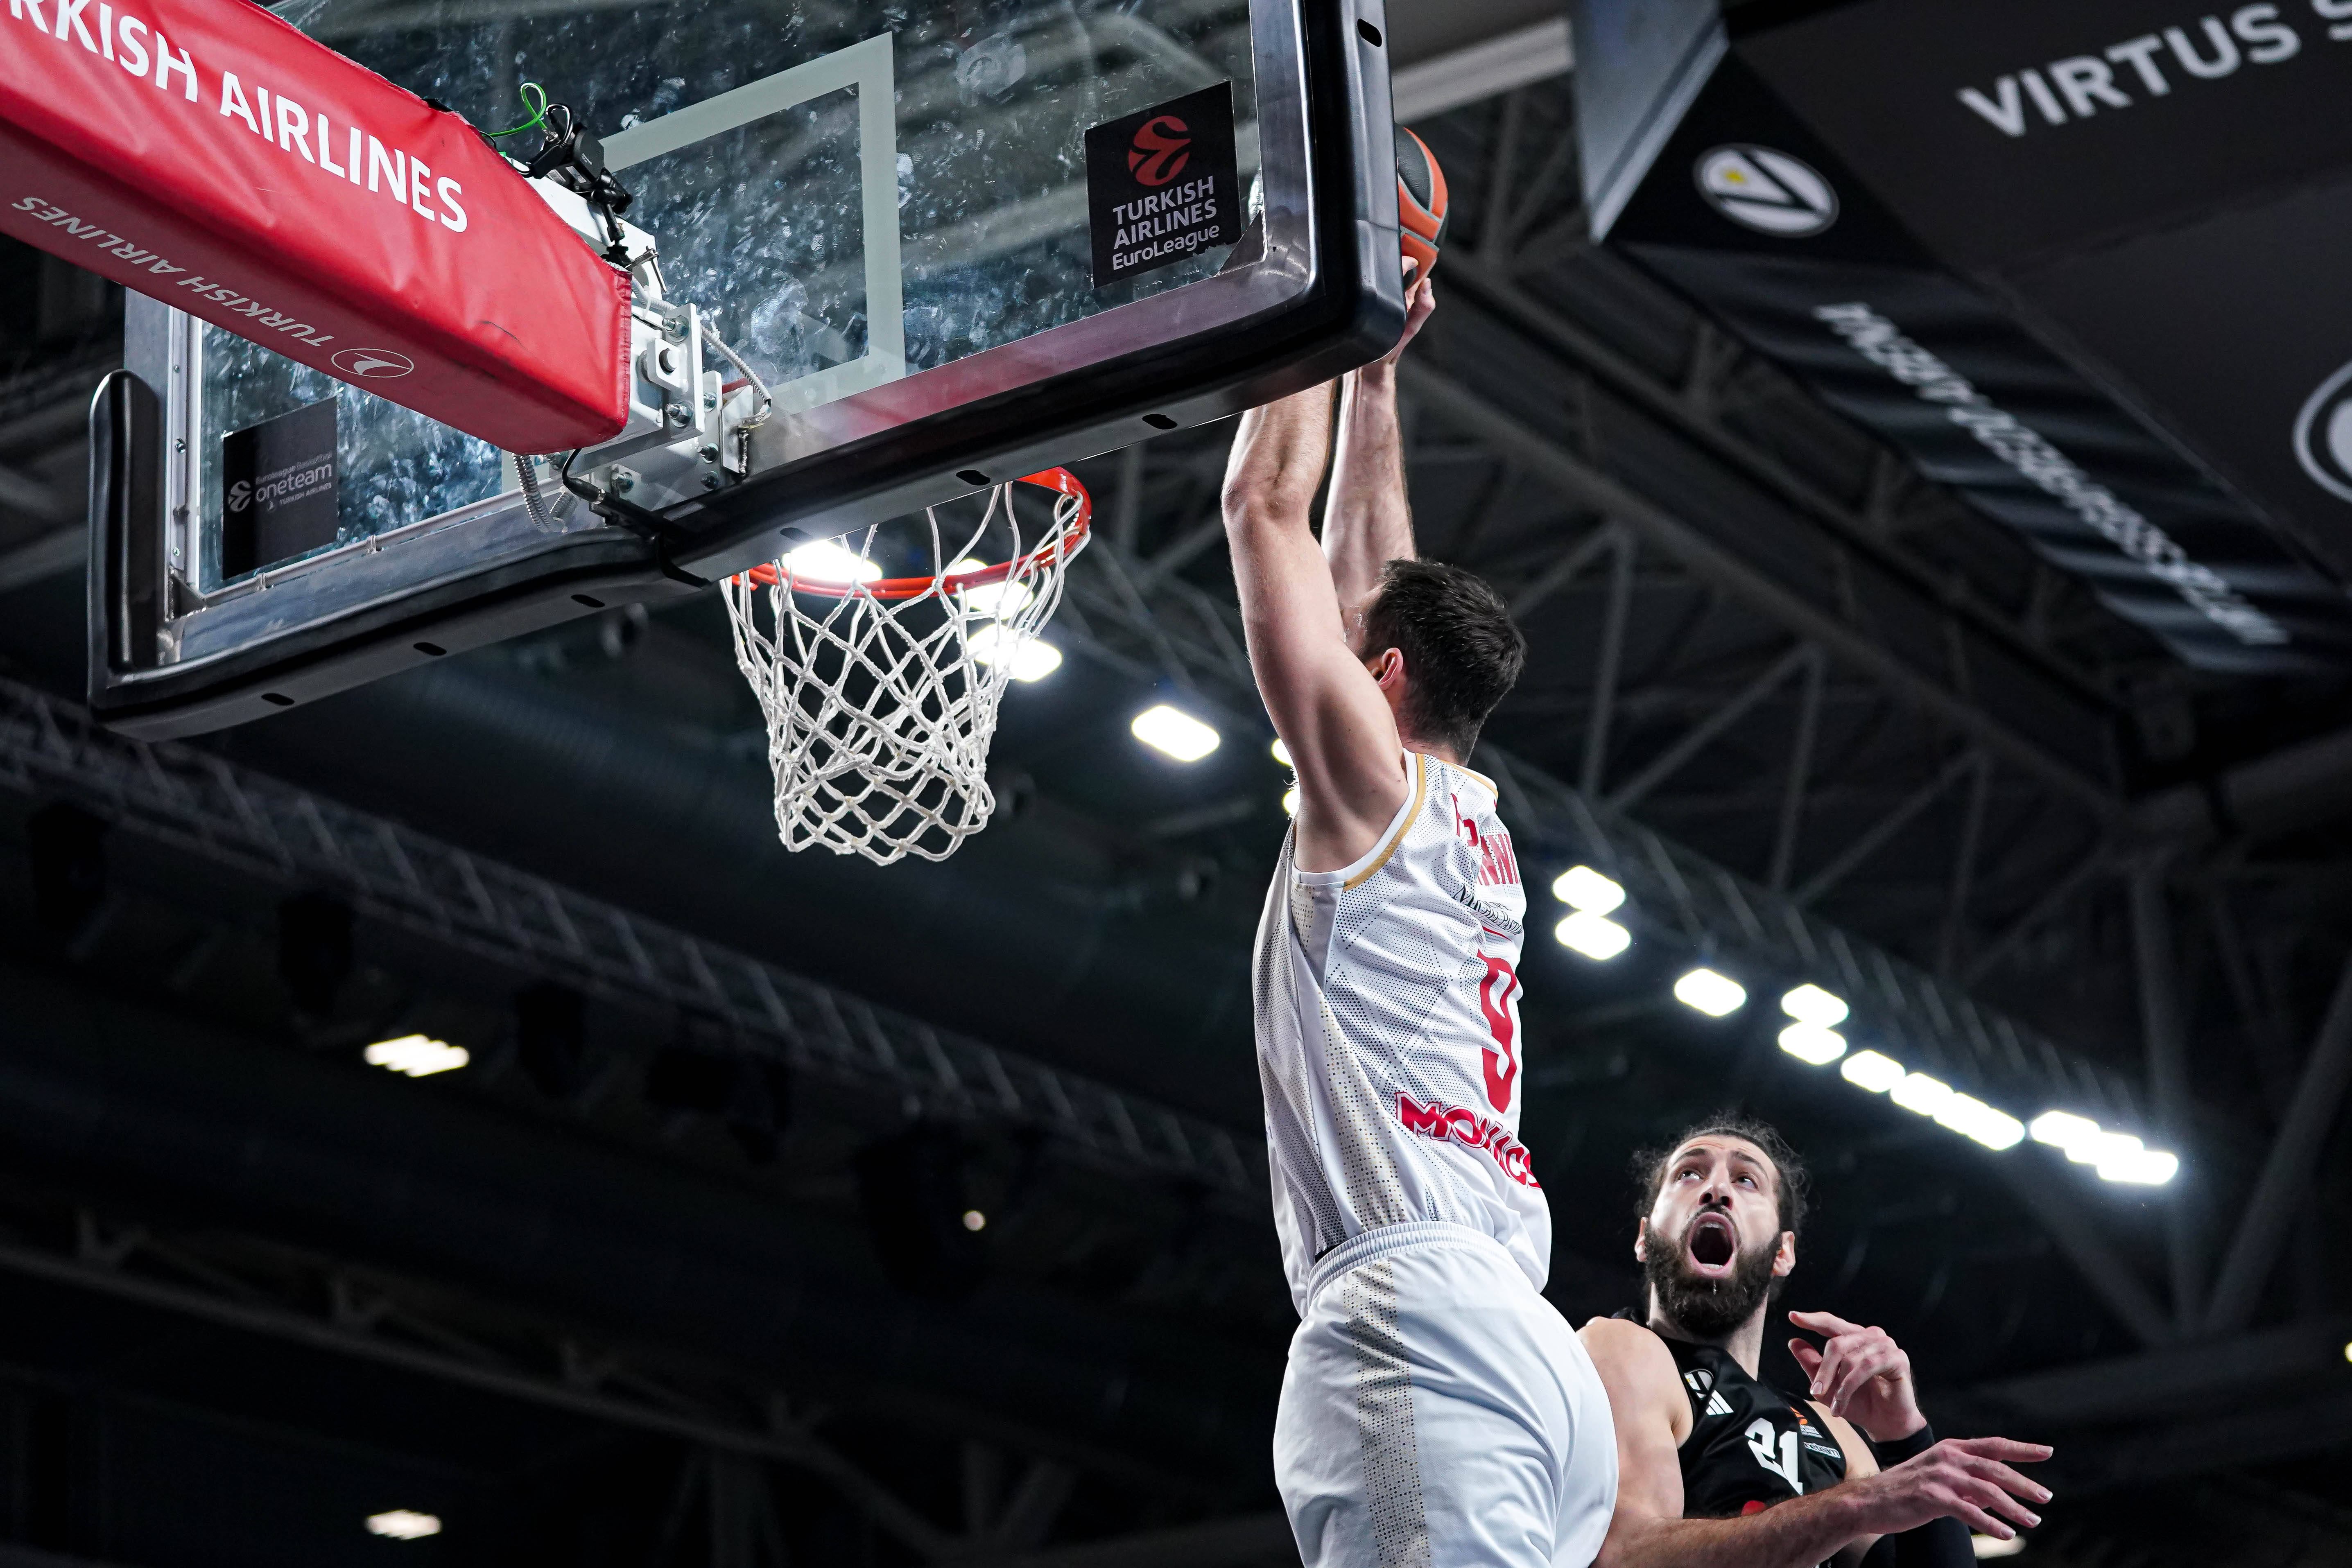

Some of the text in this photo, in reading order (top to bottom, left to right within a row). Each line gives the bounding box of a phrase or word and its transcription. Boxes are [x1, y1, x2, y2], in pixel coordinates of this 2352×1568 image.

[1957, 3, 2301, 137] VIRTUS
[219, 70, 467, 233] AIRLINES
[1113, 175, 1214, 225] TURKISH
[1113, 198, 1217, 250] AIRLINES
[11, 197, 334, 347] TURKISH AIRLINES
[1113, 225, 1219, 270] EuroLeague
[256, 463, 332, 502] oneteam
[1496, 910, 1524, 935] PASTO
[1477, 949, 1517, 1114] 9
[1744, 1417, 1803, 1496] 21
